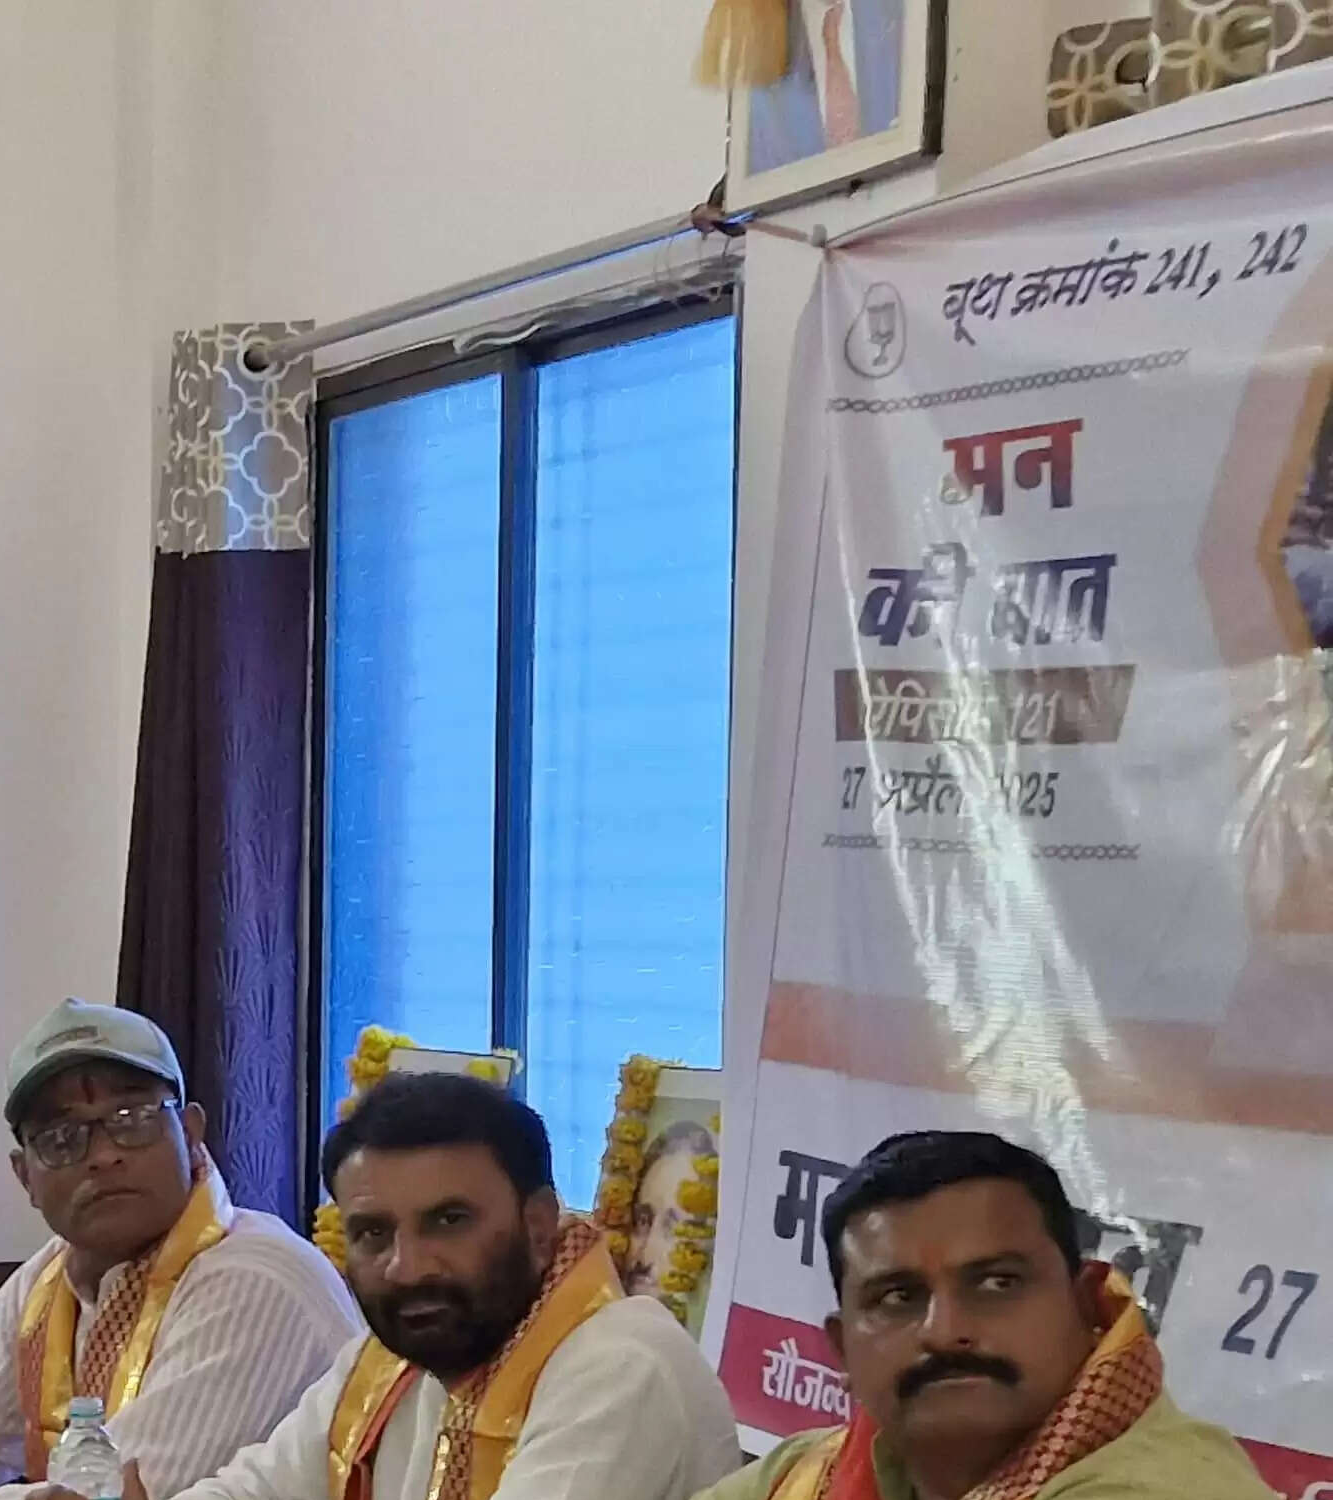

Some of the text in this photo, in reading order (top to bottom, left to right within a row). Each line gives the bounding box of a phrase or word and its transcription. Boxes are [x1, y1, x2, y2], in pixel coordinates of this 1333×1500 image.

[1010, 238, 1150, 317] क्रमांक
[1144, 240, 1224, 300] 241,
[1234, 222, 1308, 282] 242
[941, 418, 1084, 517] मन
[1007, 688, 1062, 739] 121
[841, 766, 867, 810] 27
[1220, 1263, 1320, 1361] 27
